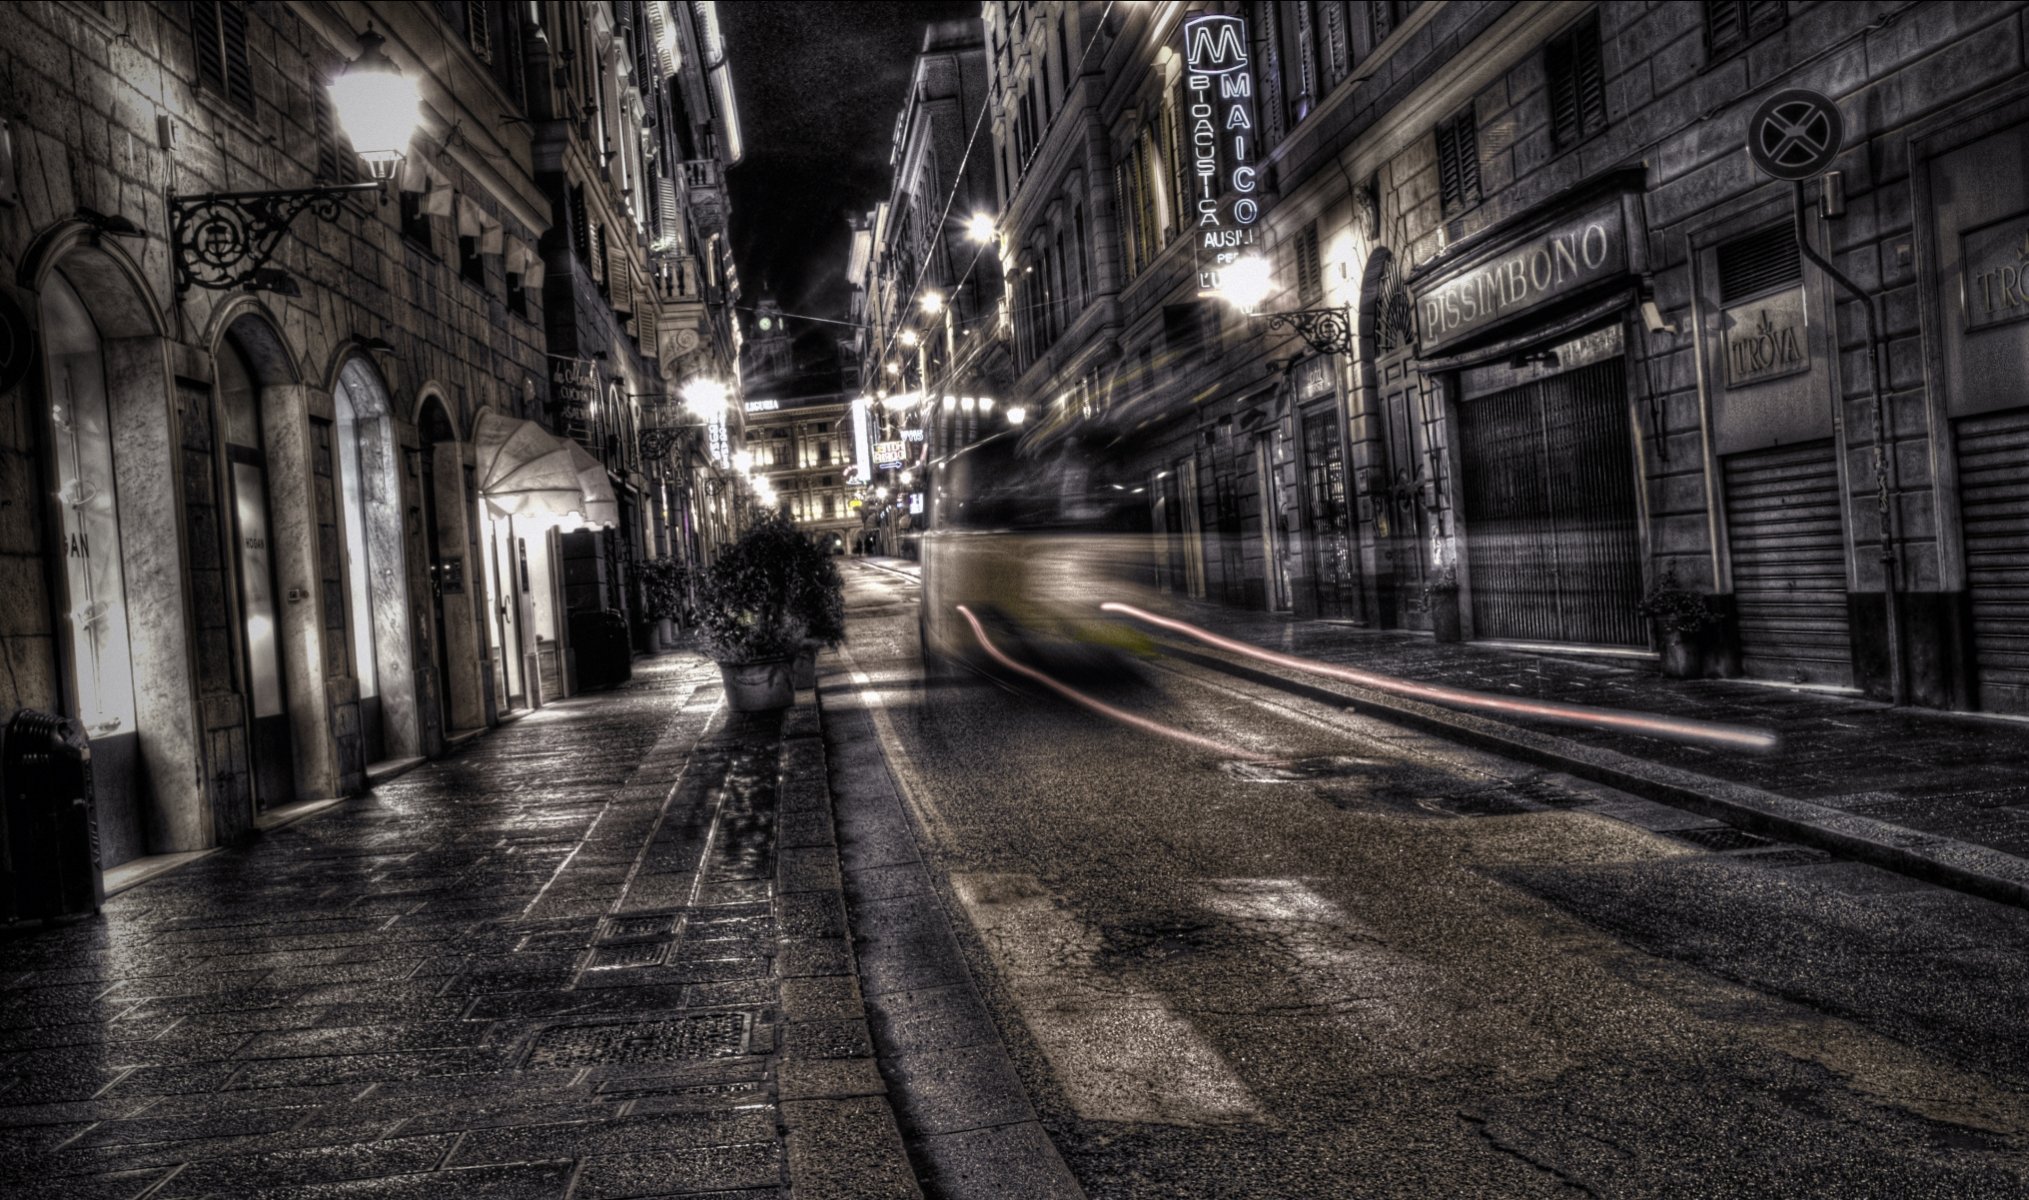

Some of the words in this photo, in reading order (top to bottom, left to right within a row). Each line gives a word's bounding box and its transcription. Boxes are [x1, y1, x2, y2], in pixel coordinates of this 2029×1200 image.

[1189, 75, 1220, 227] BIOACUSTICA
[1220, 73, 1258, 224] MAICO
[1424, 223, 1607, 342] PISSIMBONO
[1732, 327, 1803, 376] TROVA
